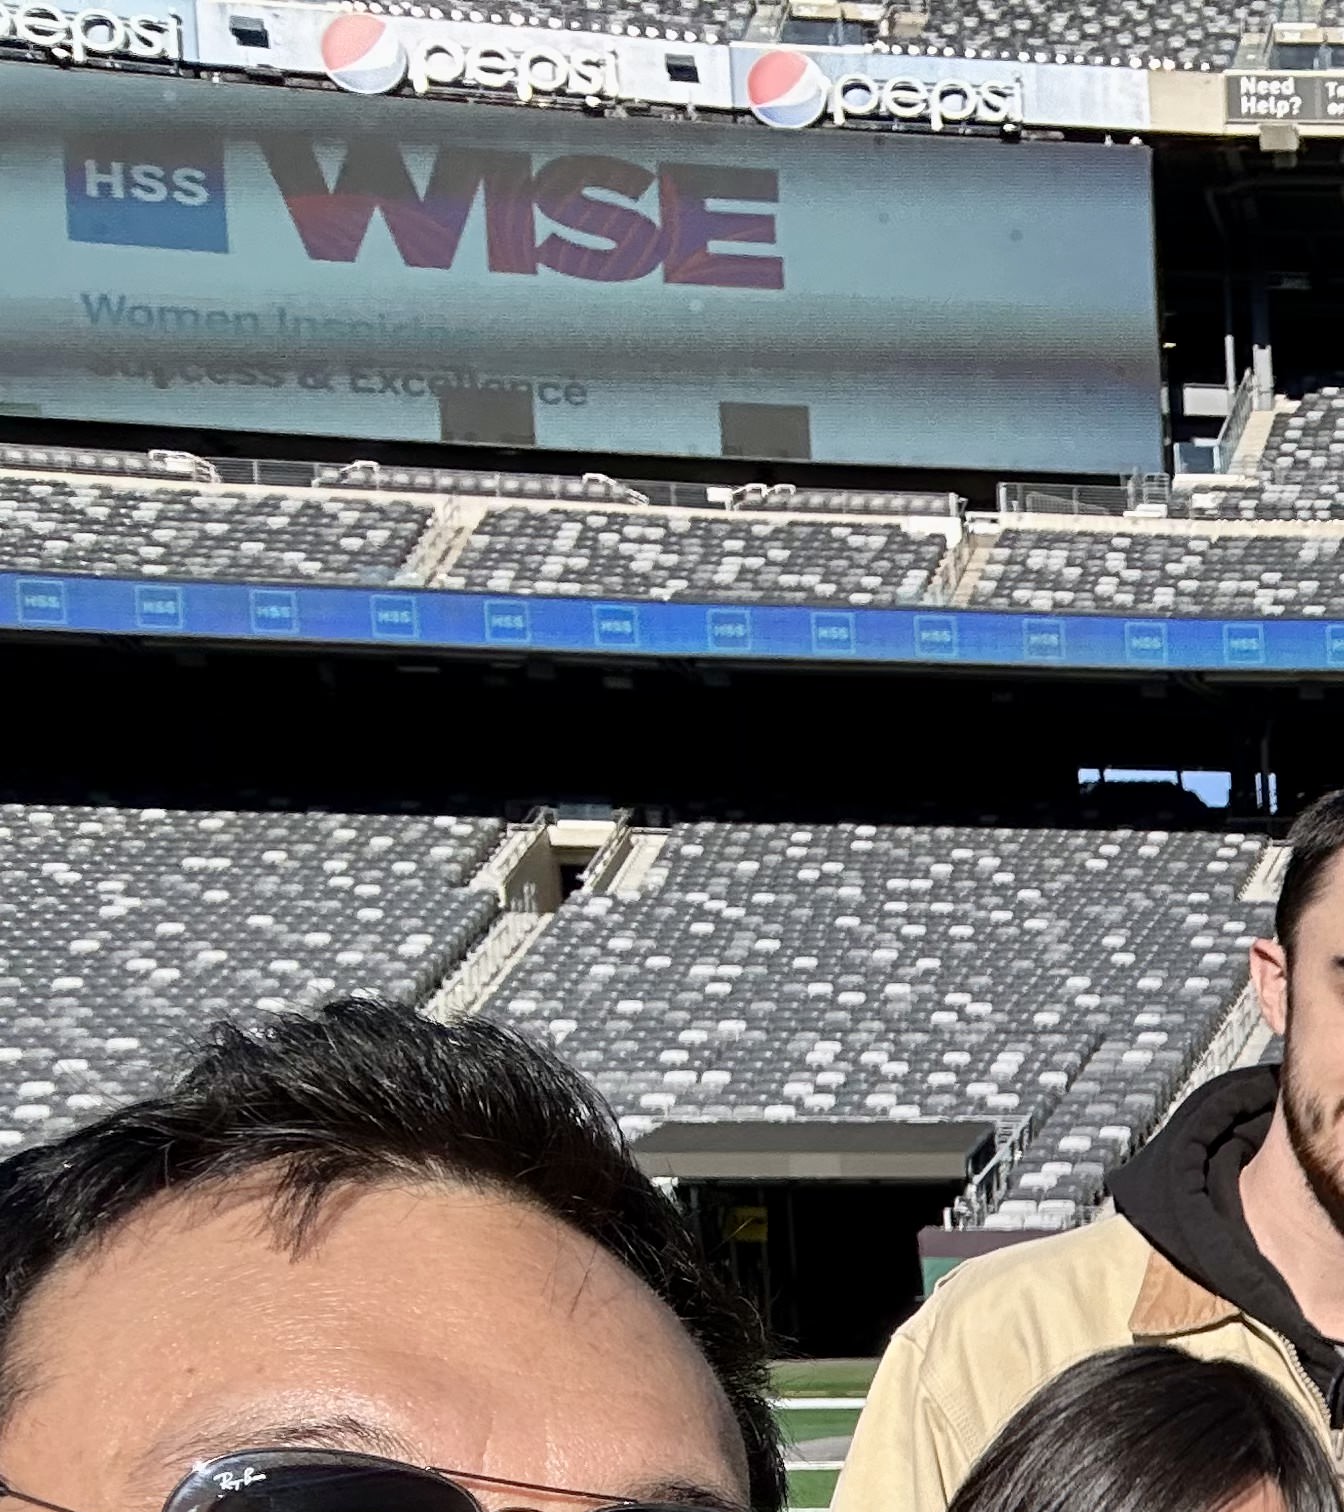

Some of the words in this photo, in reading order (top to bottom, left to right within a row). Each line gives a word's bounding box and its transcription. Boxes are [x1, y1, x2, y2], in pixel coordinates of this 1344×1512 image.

[0, 2, 180, 63] epsi
[410, 37, 619, 101] pepsi
[1239, 76, 1296, 95] Need
[833, 73, 1023, 131] pepsi
[1239, 96, 1303, 118] Help?
[84, 159, 210, 205] HSS
[256, 140, 785, 289] WISE
[81, 292, 260, 336] Women
